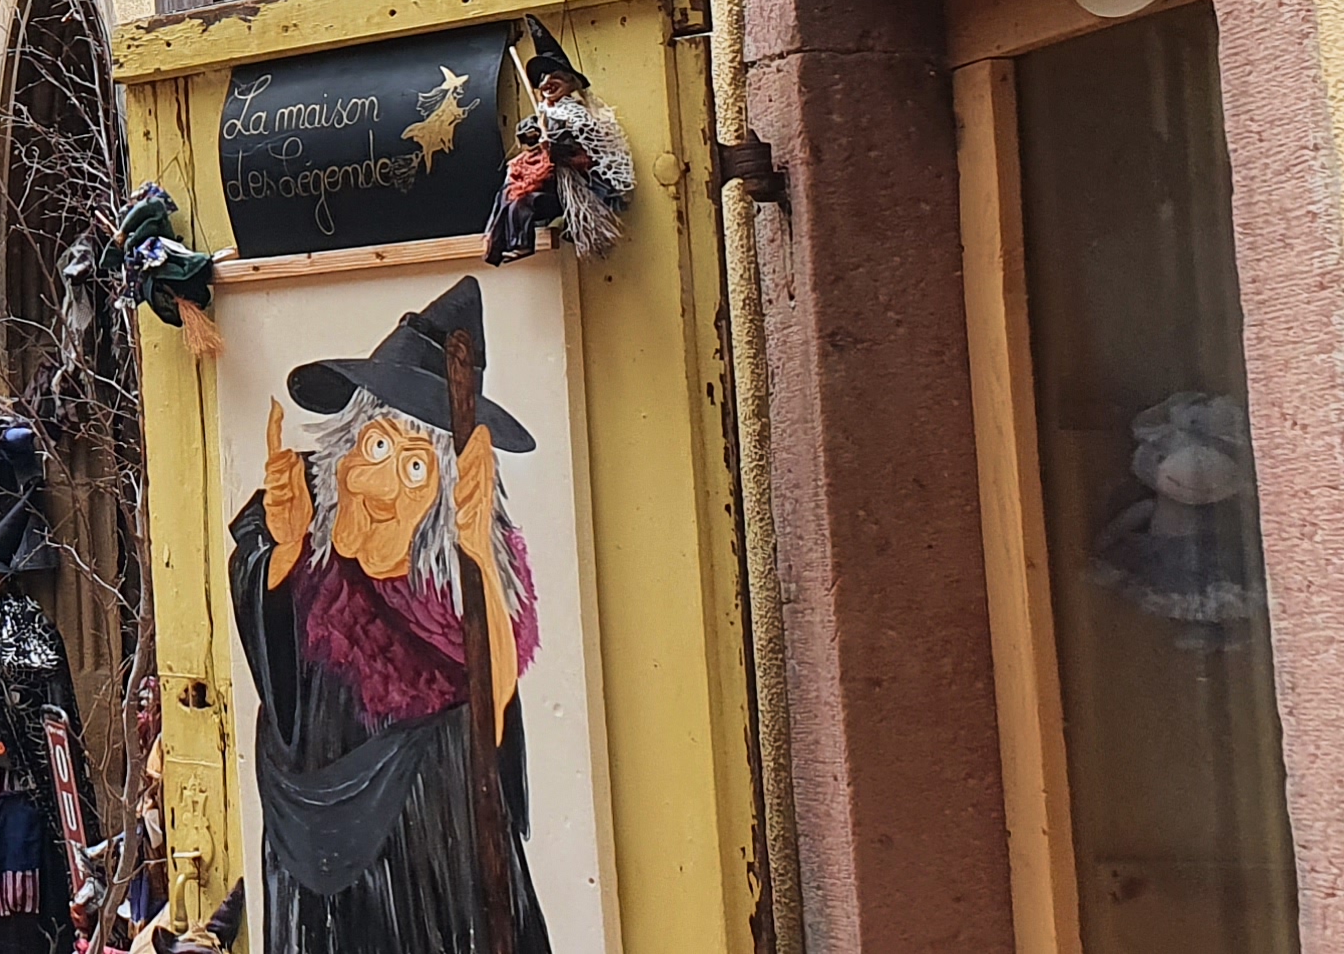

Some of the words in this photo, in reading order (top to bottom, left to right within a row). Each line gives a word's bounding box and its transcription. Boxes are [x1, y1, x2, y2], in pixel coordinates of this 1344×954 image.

[222, 74, 272, 140] La
[274, 94, 381, 133] maison
[226, 148, 277, 202] des
